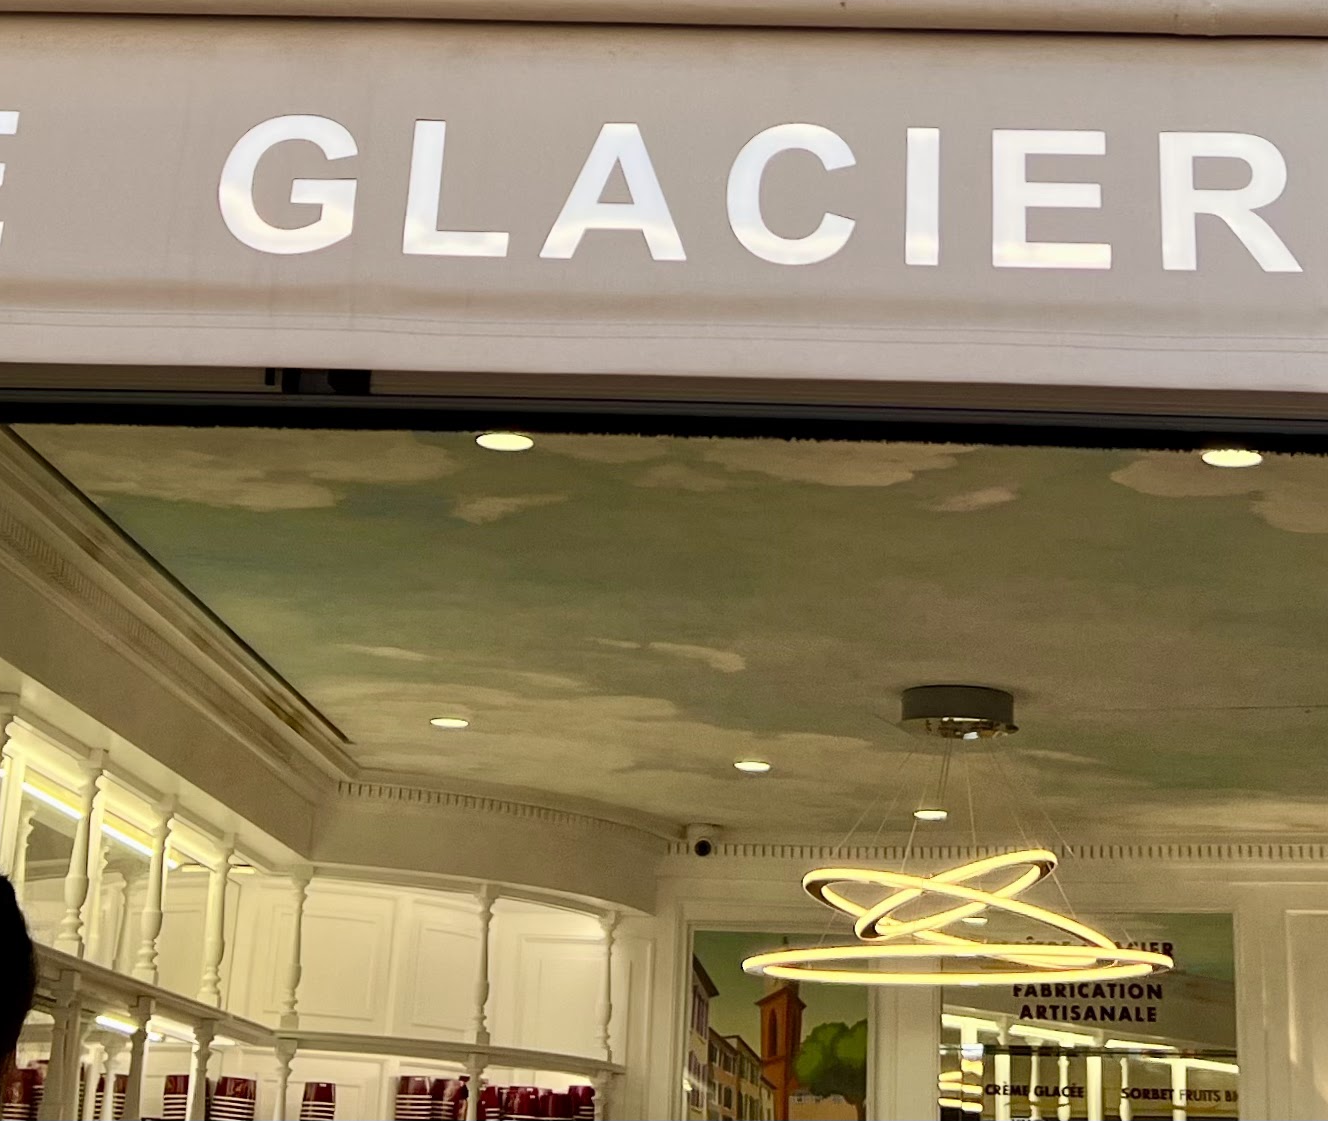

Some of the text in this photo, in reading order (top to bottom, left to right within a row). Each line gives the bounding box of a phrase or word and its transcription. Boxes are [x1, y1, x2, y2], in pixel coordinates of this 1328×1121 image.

[218, 112, 1304, 272] GLACIER
[1012, 982, 1163, 1000] FABRICATION
[1018, 1004, 1158, 1023] ARTISANALE
[984, 1081, 1085, 1099] CRÈME GLACÉE
[1120, 1086, 1174, 1100] SORBET
[1179, 1089, 1221, 1102] FRUITS
